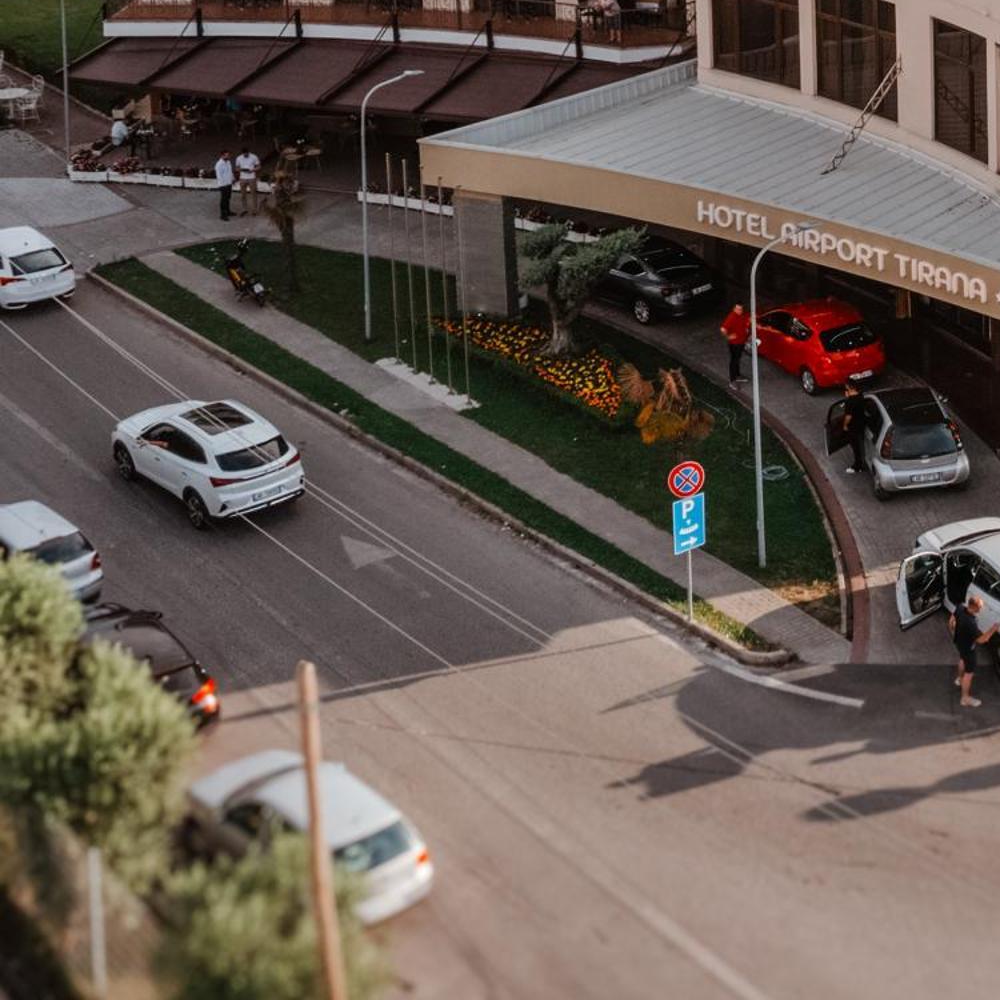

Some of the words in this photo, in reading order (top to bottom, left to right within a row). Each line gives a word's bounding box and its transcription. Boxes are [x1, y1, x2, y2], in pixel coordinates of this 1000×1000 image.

[697, 201, 775, 240] HOTEL
[781, 222, 890, 272] AIRPORT
[894, 253, 988, 304] TIRANA
[682, 500, 695, 520] P
